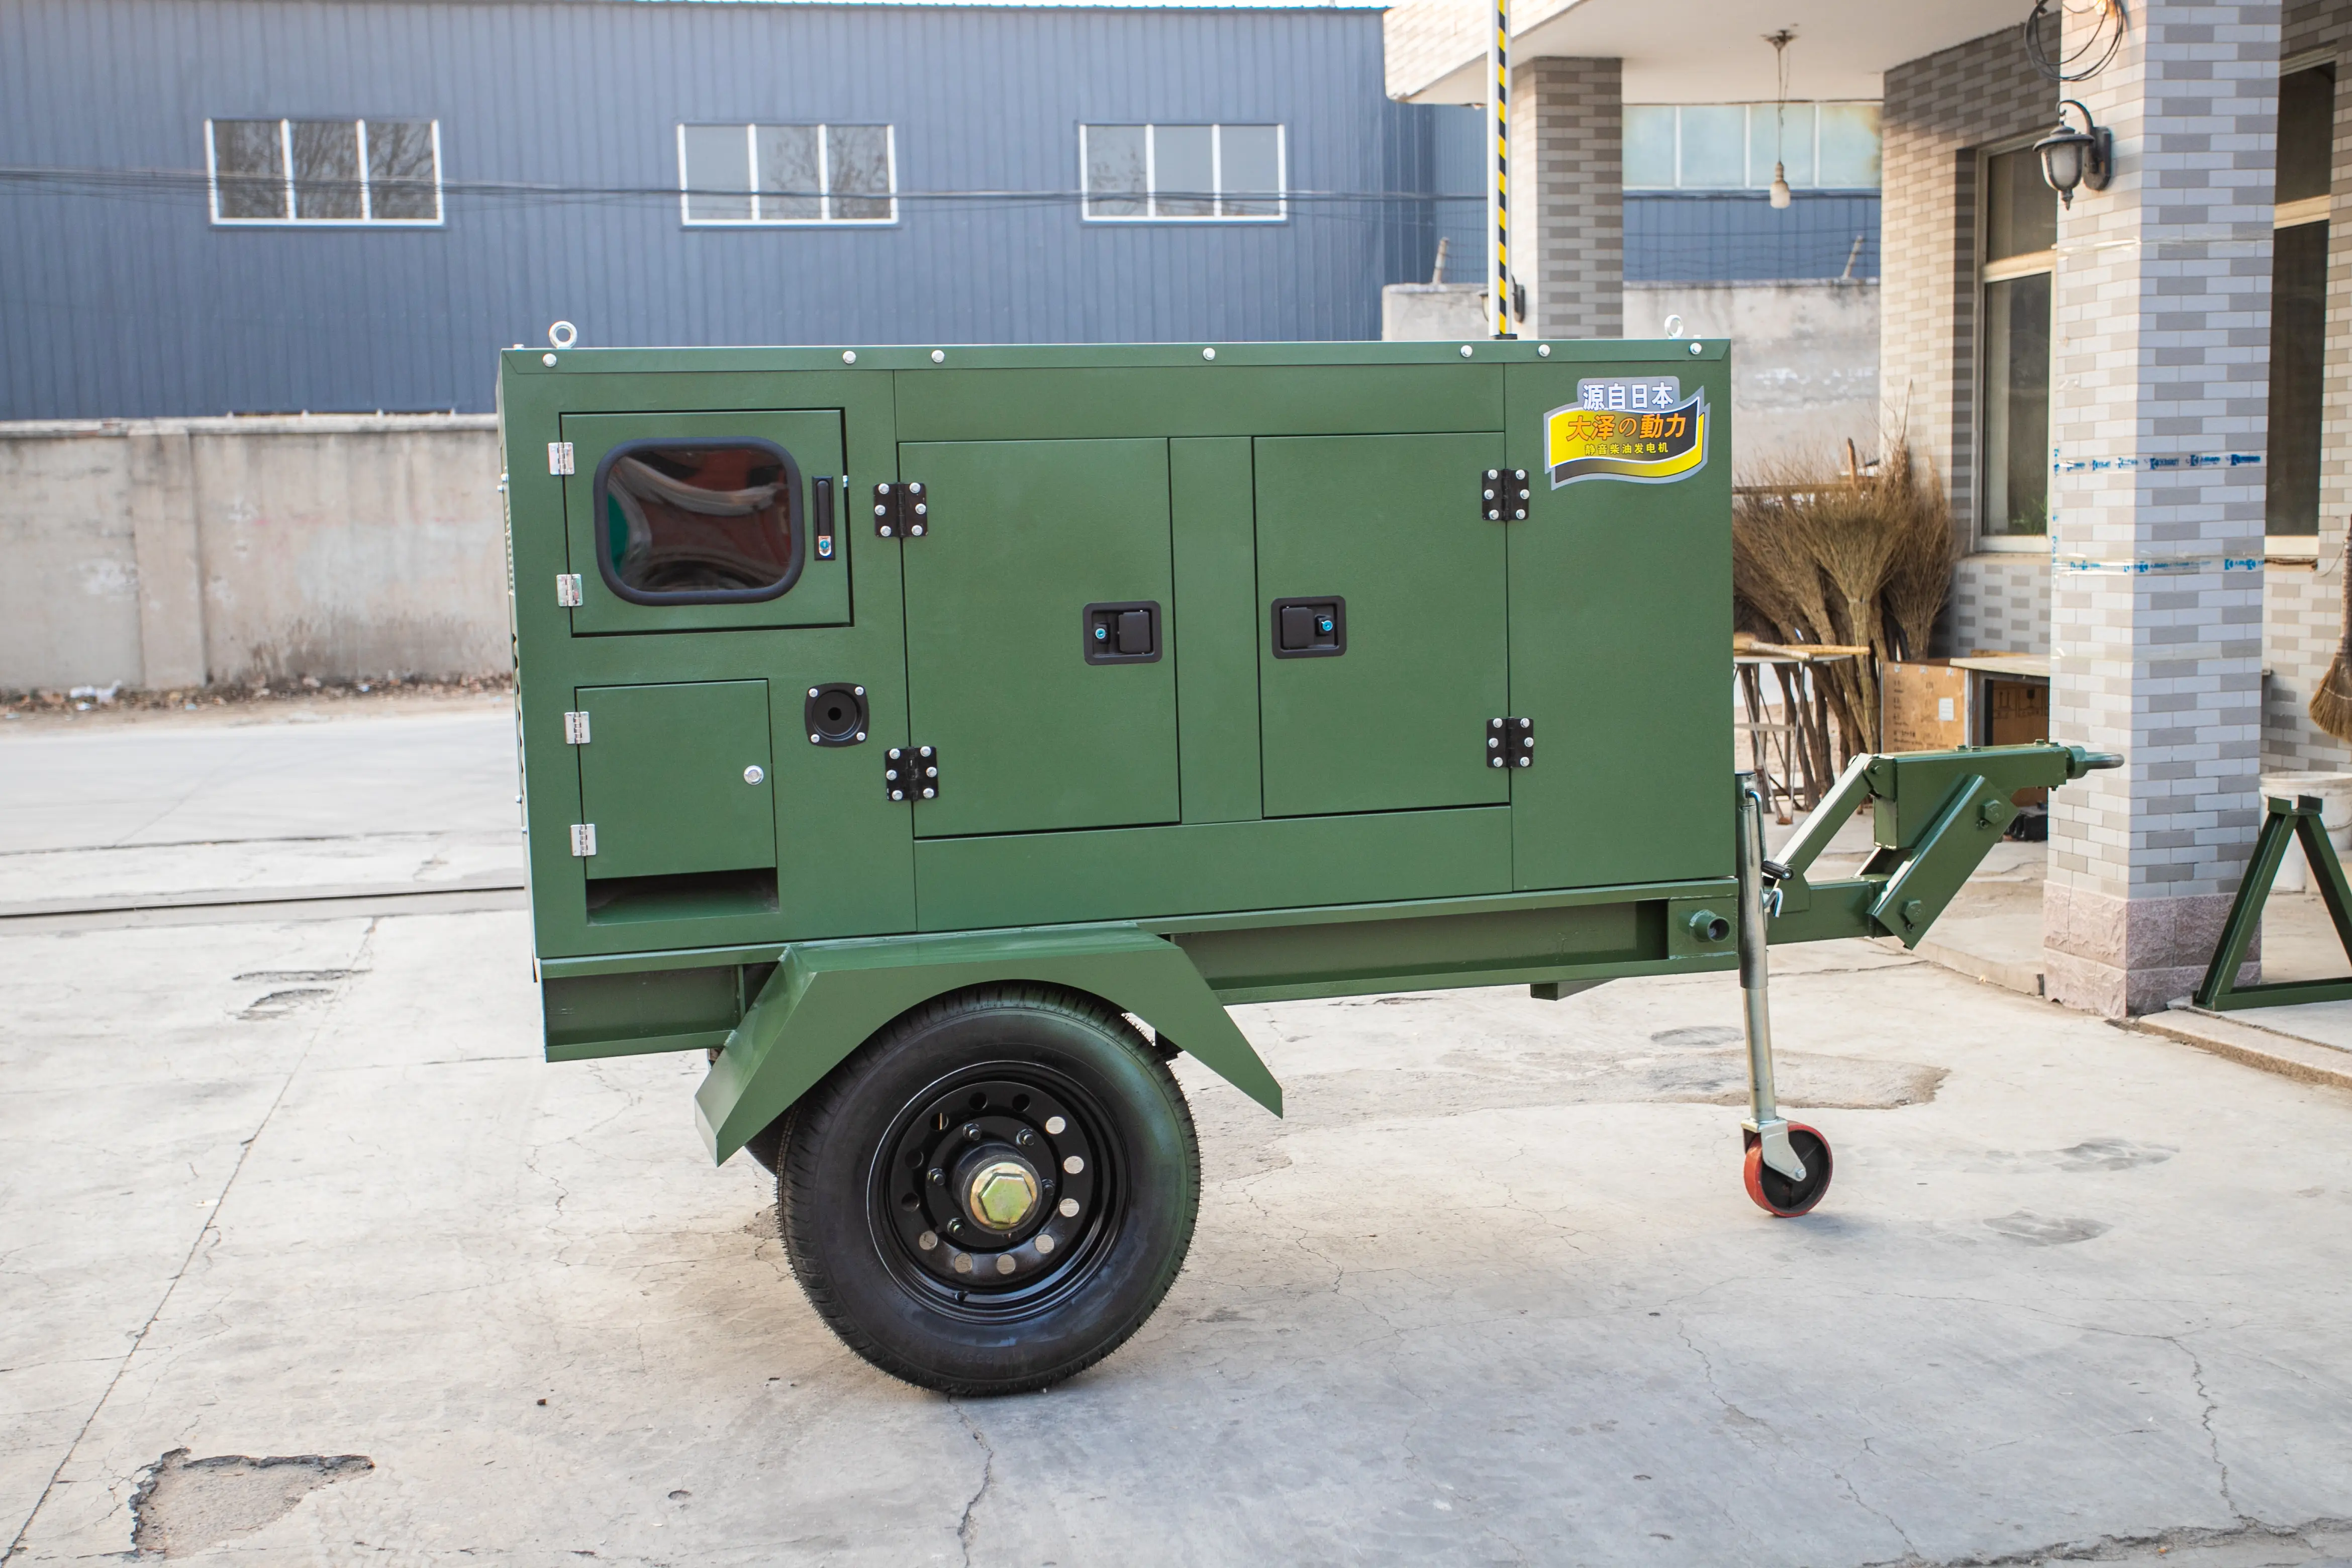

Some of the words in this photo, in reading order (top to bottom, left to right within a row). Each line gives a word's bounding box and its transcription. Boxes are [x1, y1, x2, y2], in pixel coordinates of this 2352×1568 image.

[1583, 382, 1674, 411] 源自日本
[1566, 413, 1686, 441] 大泽の動力
[1584, 442, 1669, 455] 静音柴油发电机
